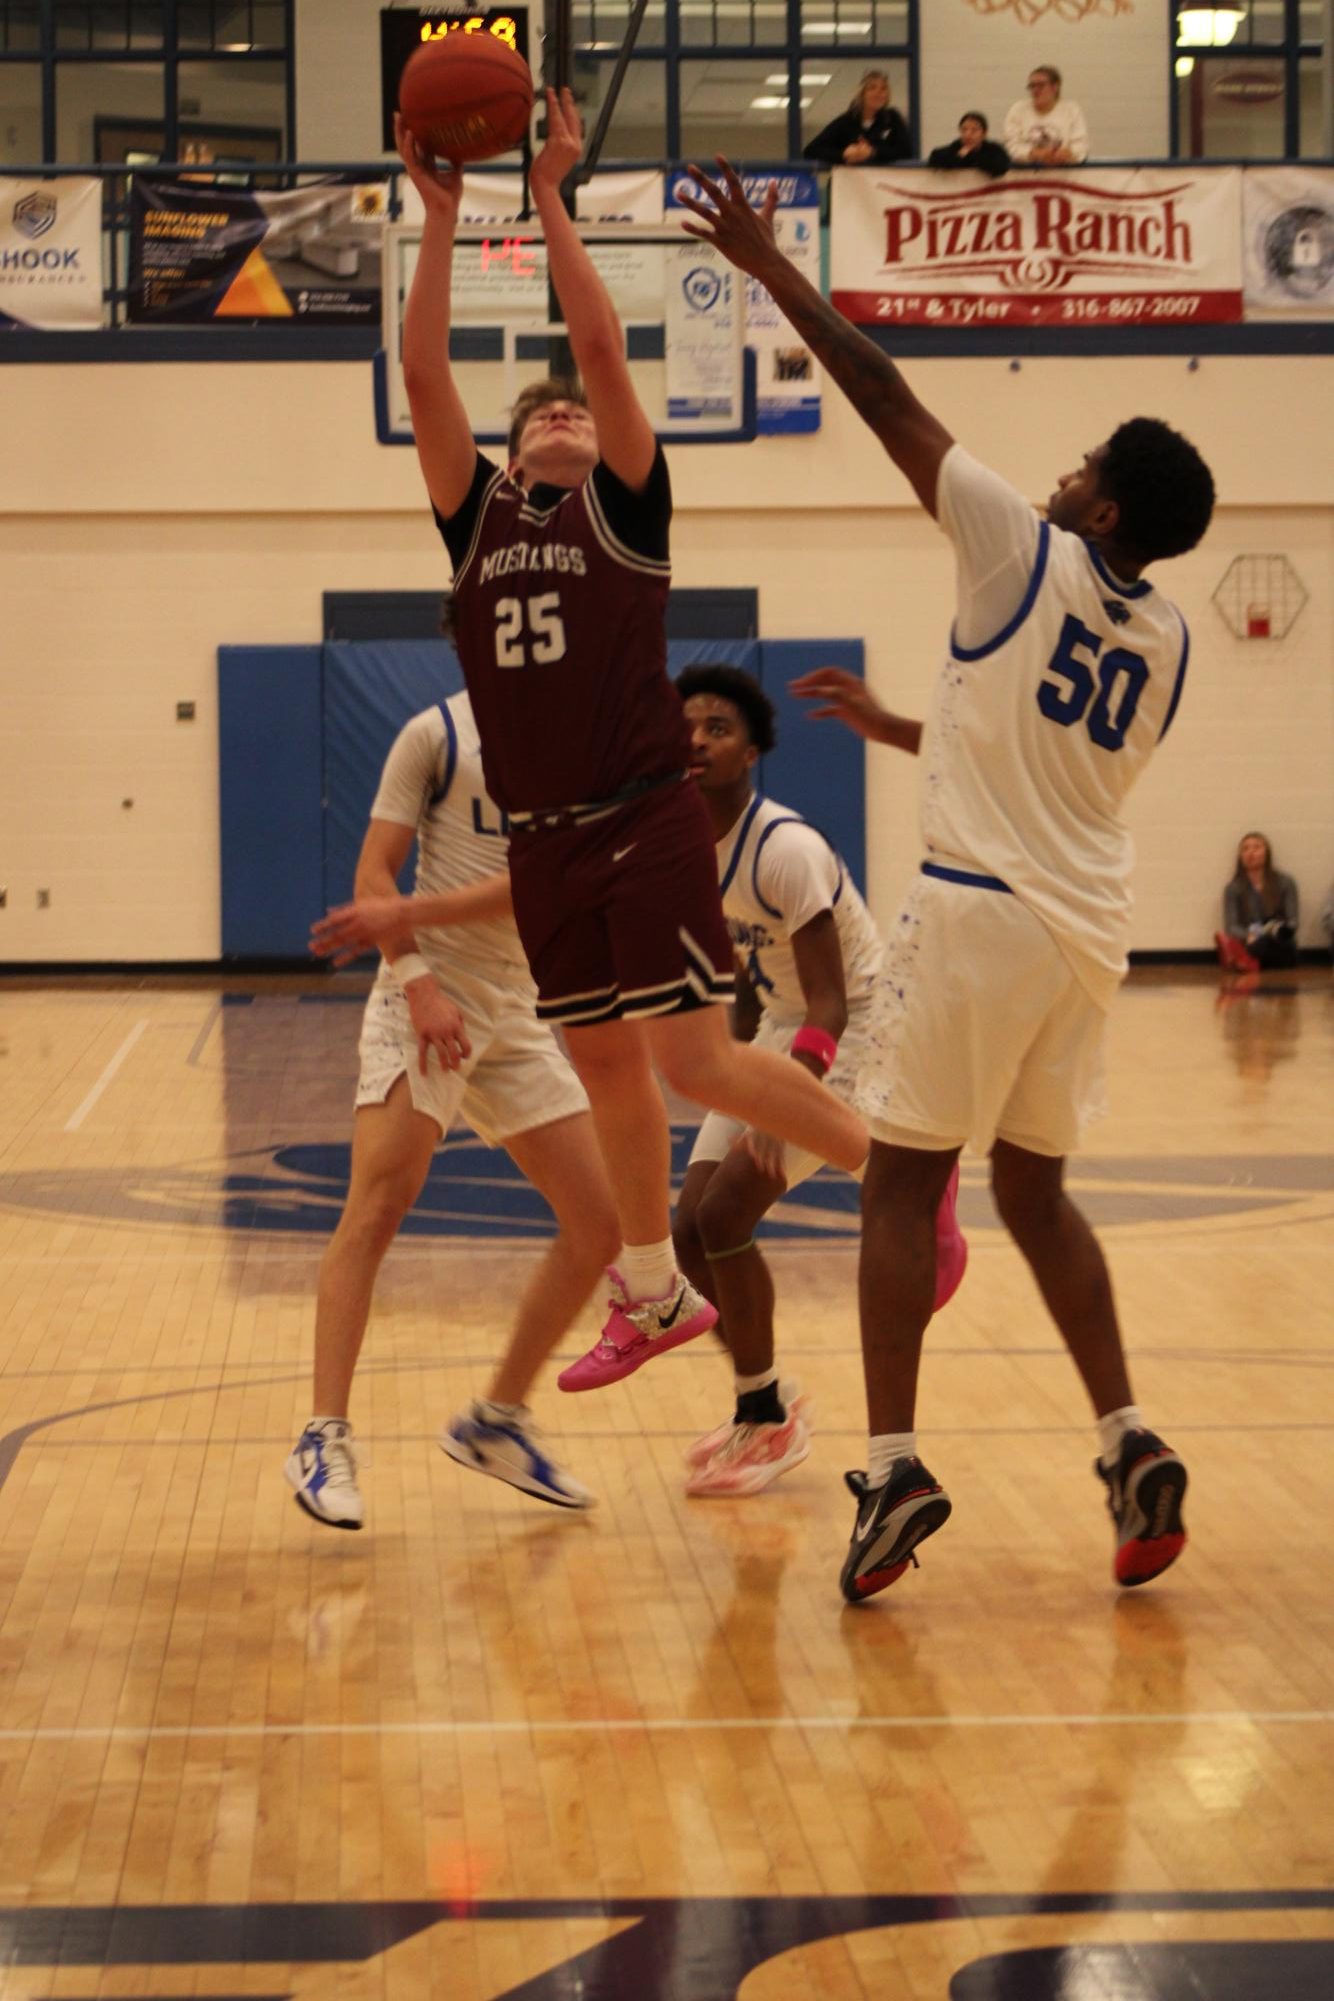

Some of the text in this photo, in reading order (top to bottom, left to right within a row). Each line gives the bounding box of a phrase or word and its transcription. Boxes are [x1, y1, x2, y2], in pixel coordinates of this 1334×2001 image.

[883, 194, 1193, 264] Pizza Ranch
[0, 247, 80, 270] HOOK
[925, 298, 945, 318] &
[951, 298, 1011, 322] Tyler
[1062, 296, 1200, 318] 316-867-2007
[479, 541, 588, 587] MUSTANGS
[494, 591, 568, 668] 25
[1036, 613, 1149, 753] 50
